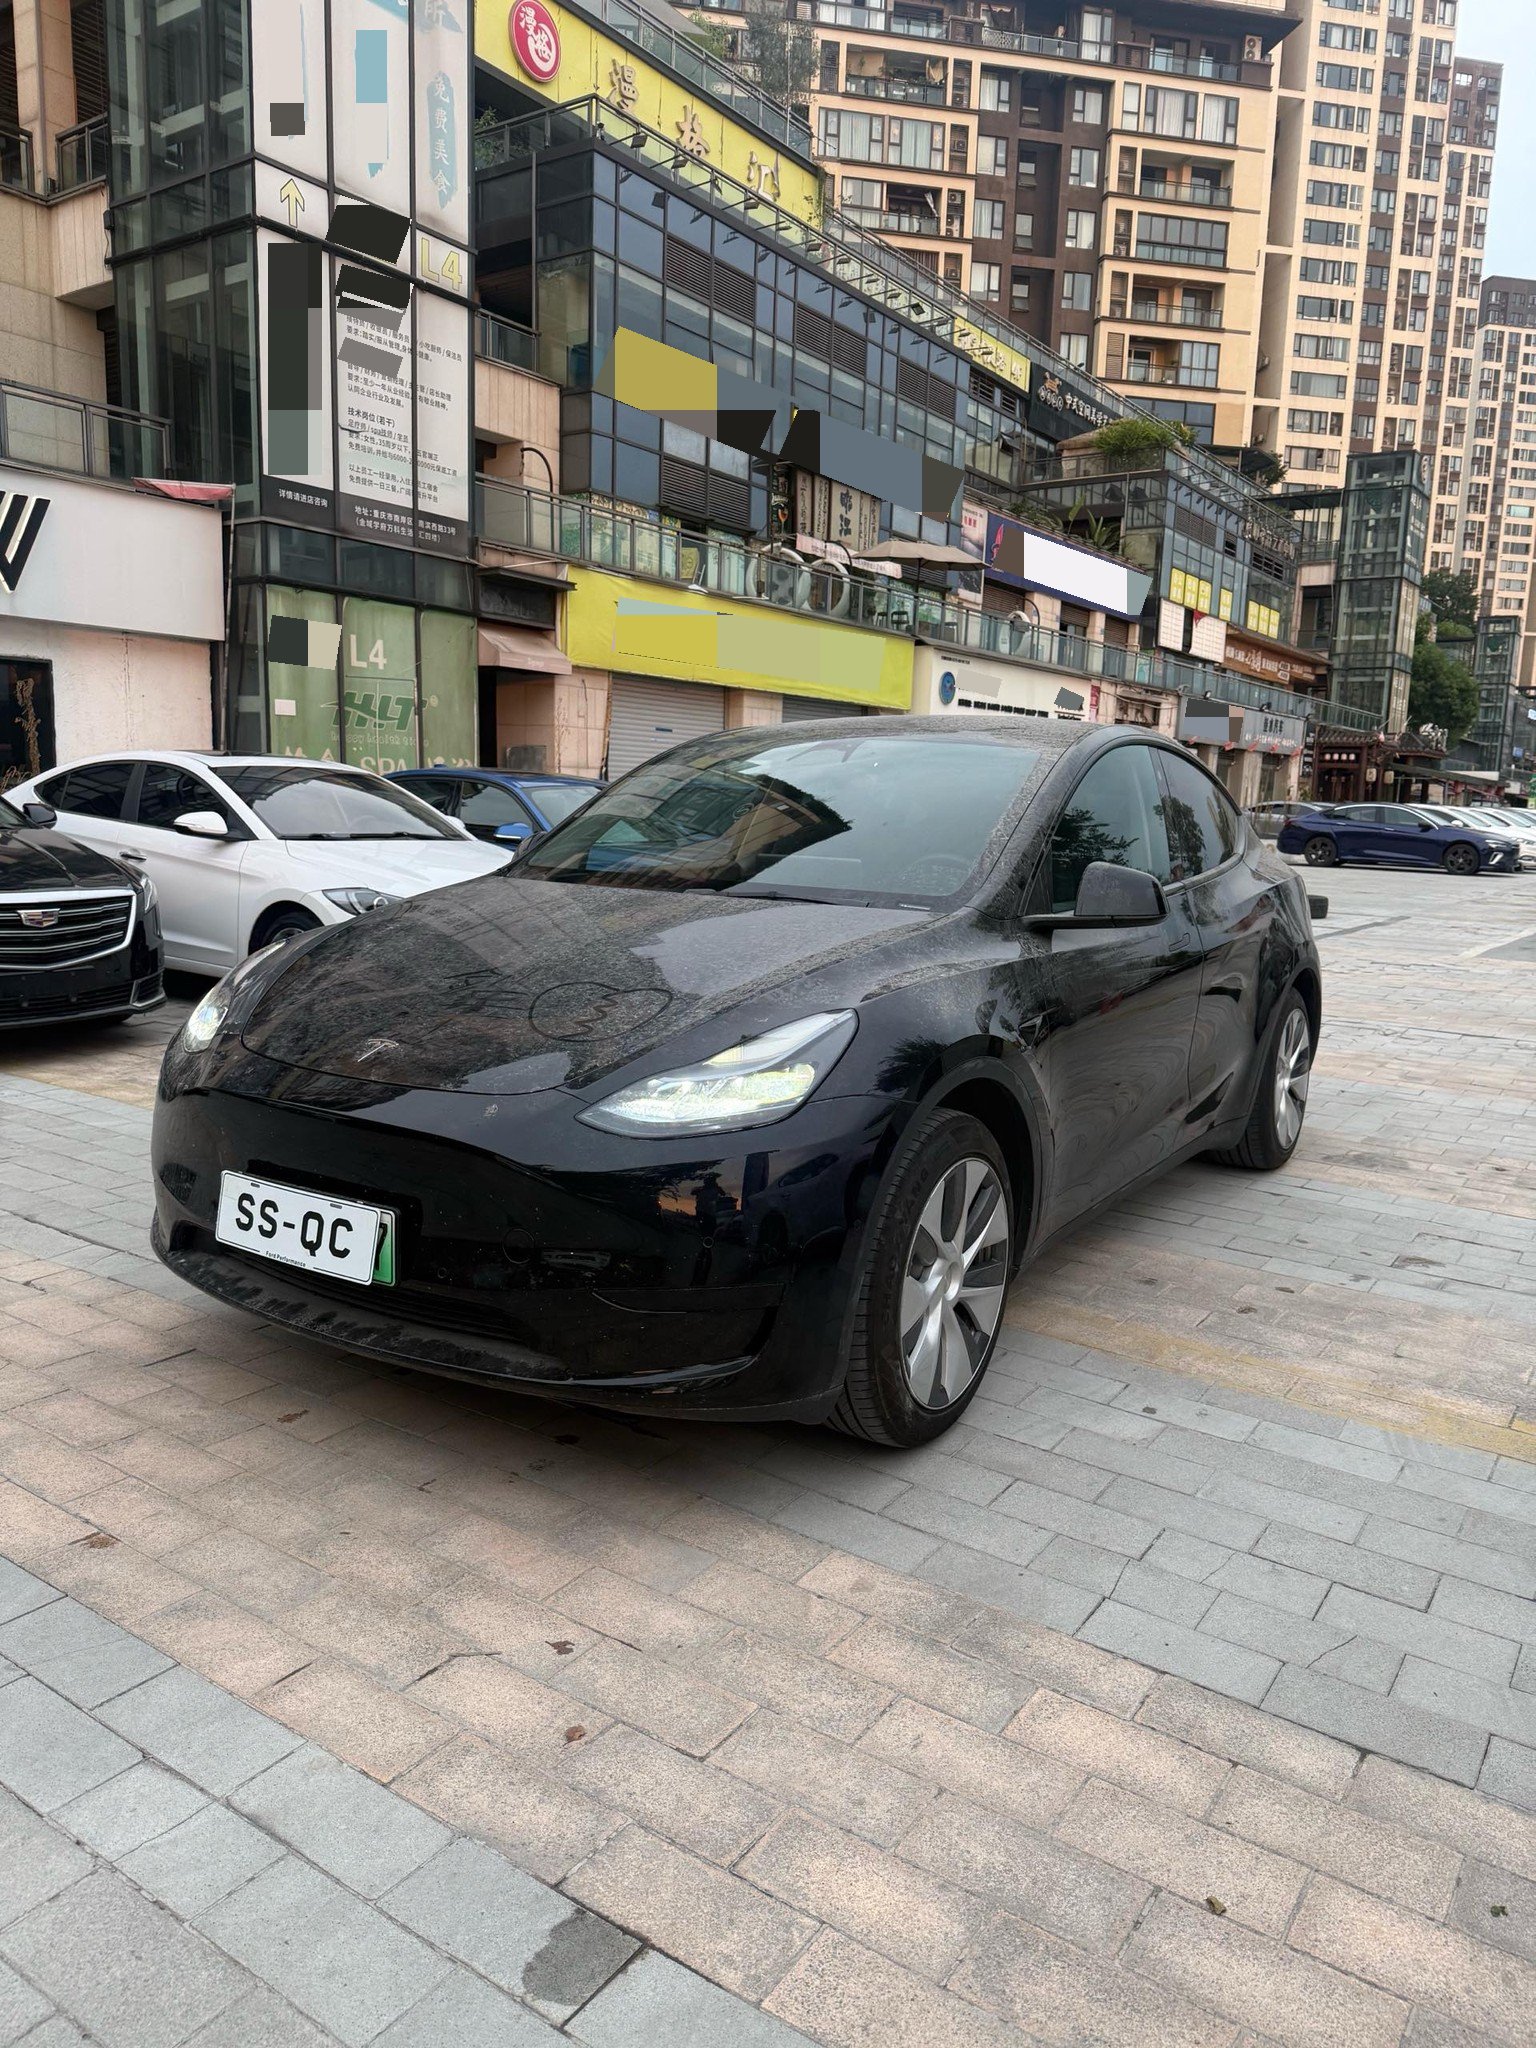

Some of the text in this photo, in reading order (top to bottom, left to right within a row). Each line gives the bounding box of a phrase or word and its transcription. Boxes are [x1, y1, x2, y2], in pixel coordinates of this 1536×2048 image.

[434, 76, 450, 195] 免费美食
[421, 237, 463, 291] L4
[278, 488, 328, 508] 详情请进店咨询
[350, 633, 387, 670] L4
[235, 1192, 354, 1259] SS-QC
[265, 1250, 306, 1268] Ford Performance
